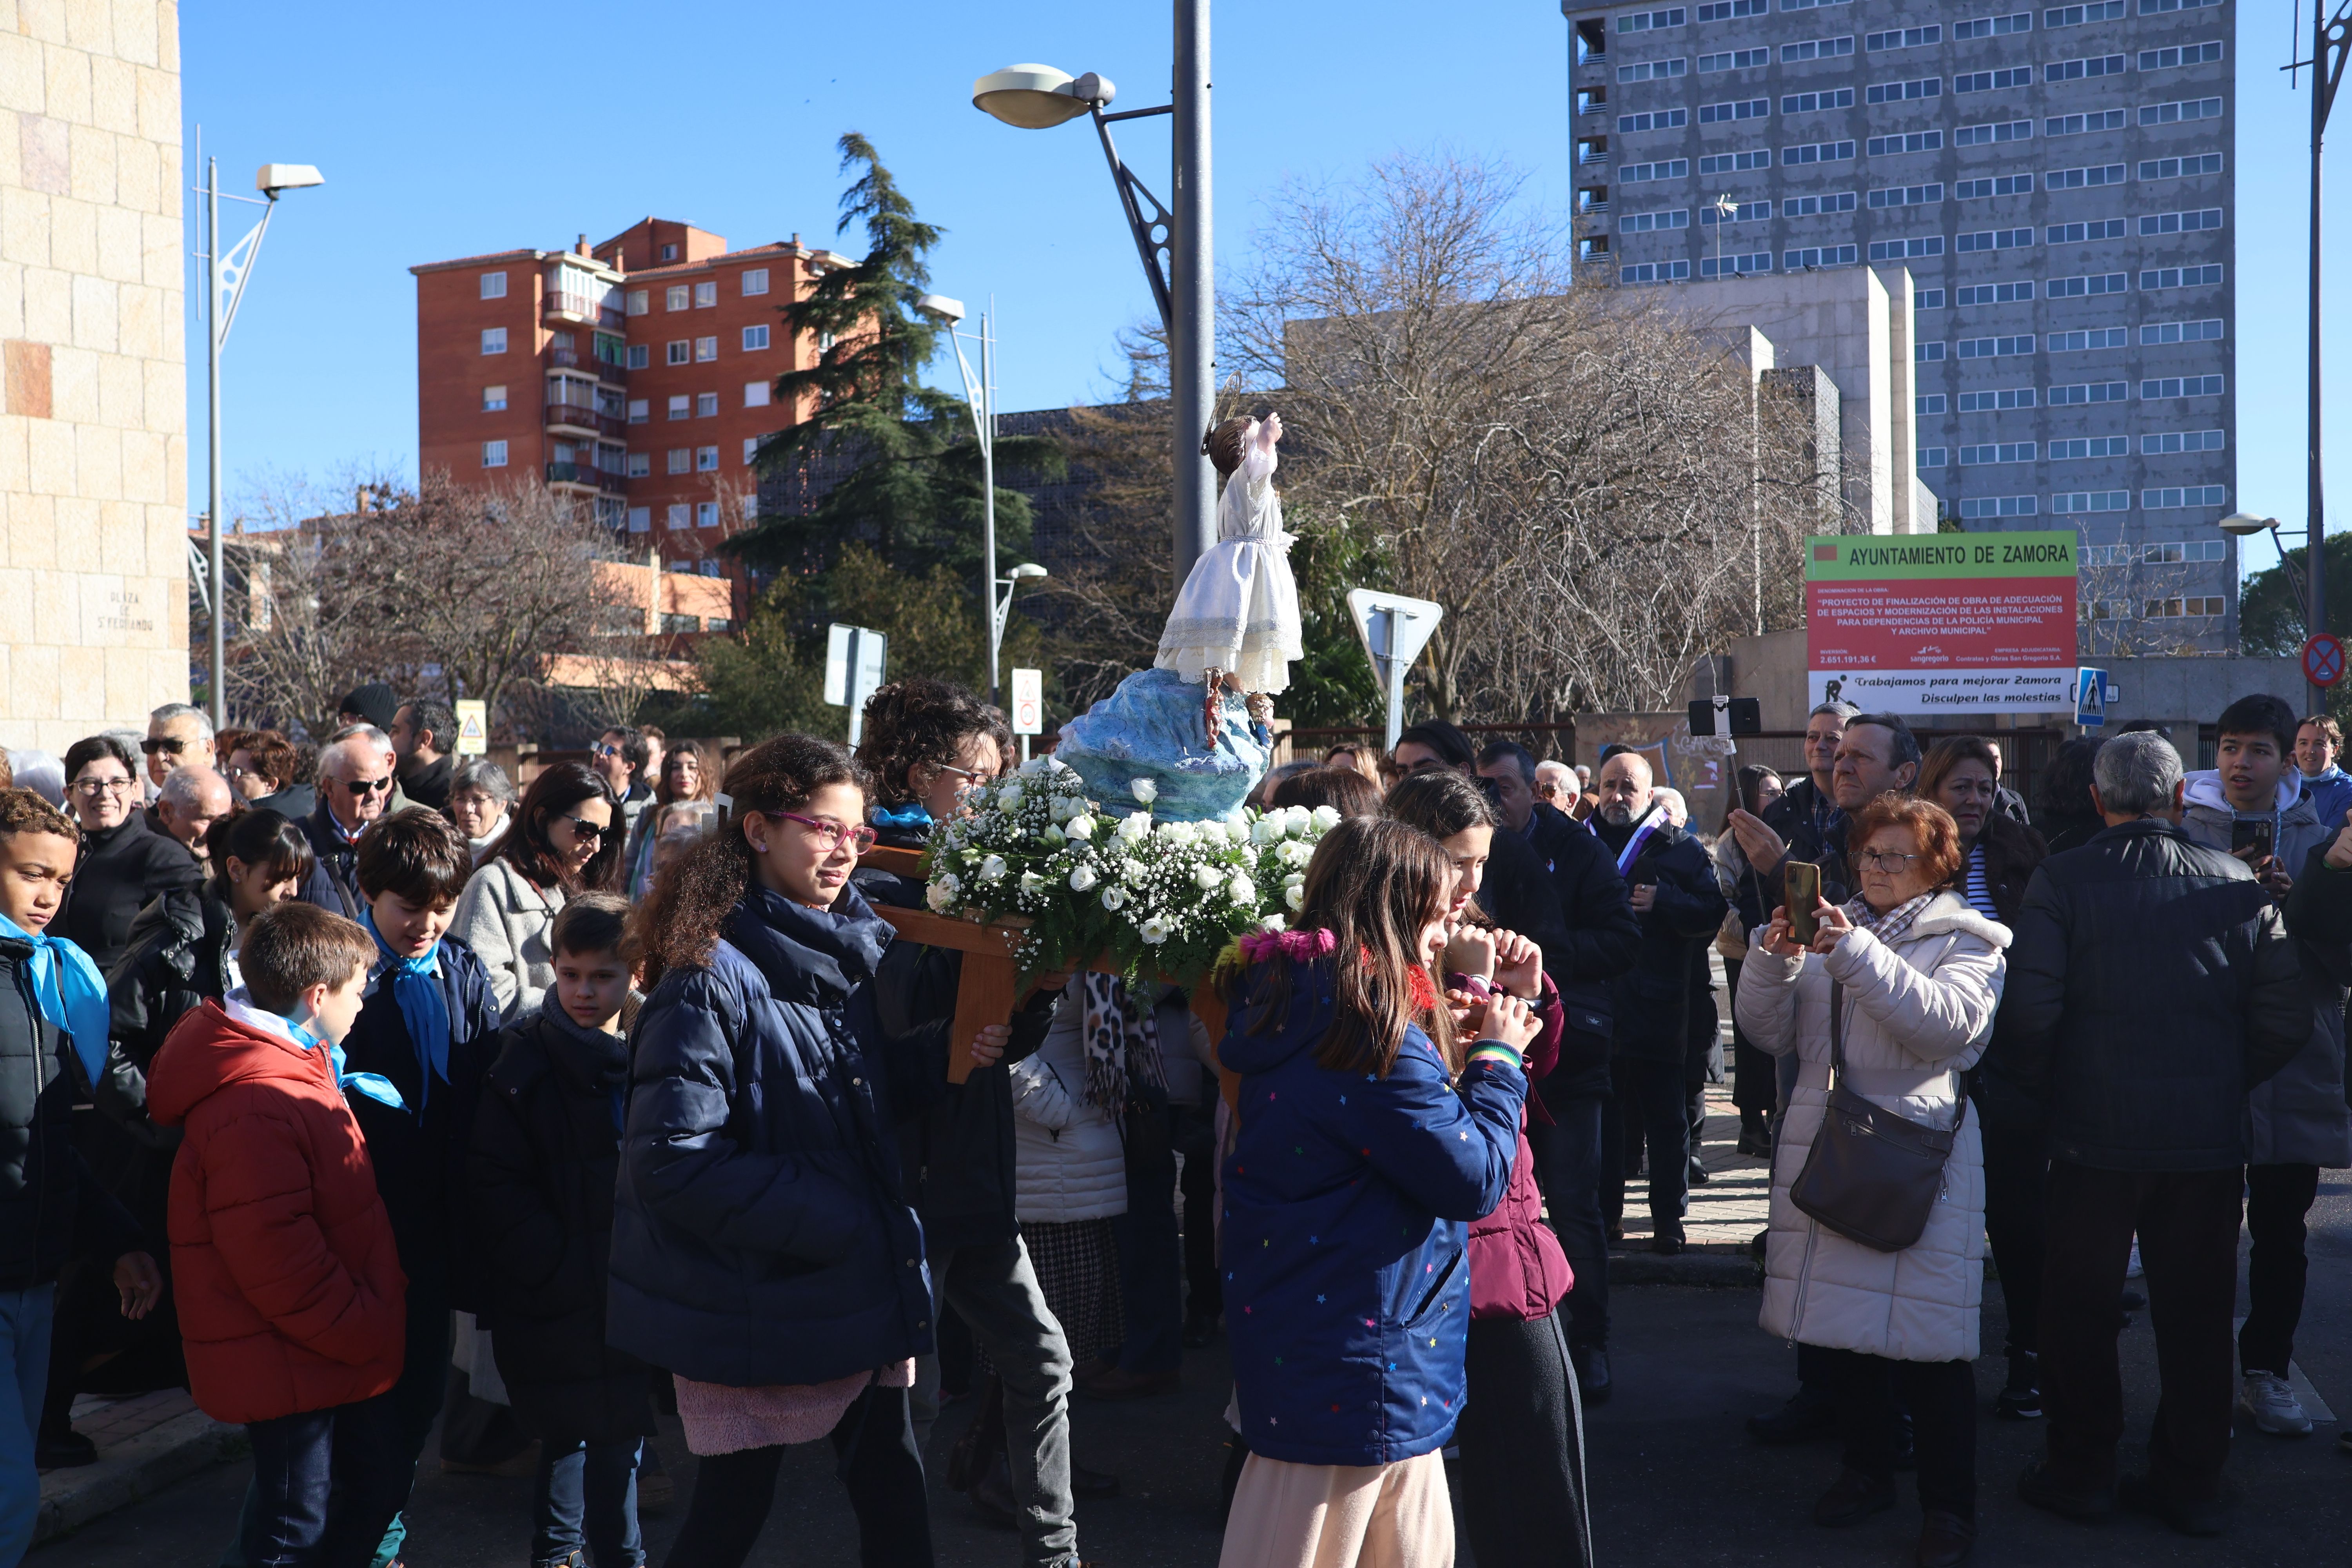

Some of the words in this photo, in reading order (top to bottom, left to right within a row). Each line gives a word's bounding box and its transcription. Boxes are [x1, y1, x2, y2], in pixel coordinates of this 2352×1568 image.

[1850, 546, 1965, 565] AYUNTAMIENTO
[1975, 546, 1994, 563] DE
[2003, 544, 2069, 563] ZAMORA
[1886, 596, 1945, 605] FINALIZACIÓN
[2004, 595, 2062, 603] ADECUACIÓN
[1885, 606, 1957, 615] MODERNIZACIÓN
[1960, 615, 1994, 624] POLICÍA
[1911, 655, 1949, 663] sangregorio
[1855, 677, 1926, 688] Trabajamos
[1930, 679, 1958, 688] para
[1963, 676, 2010, 687] mejorar
[2014, 676, 2061, 684] Zamora
[1922, 694, 1978, 704] Disculpen
[1984, 693, 2000, 702] las
[2005, 692, 2060, 702] molestias
